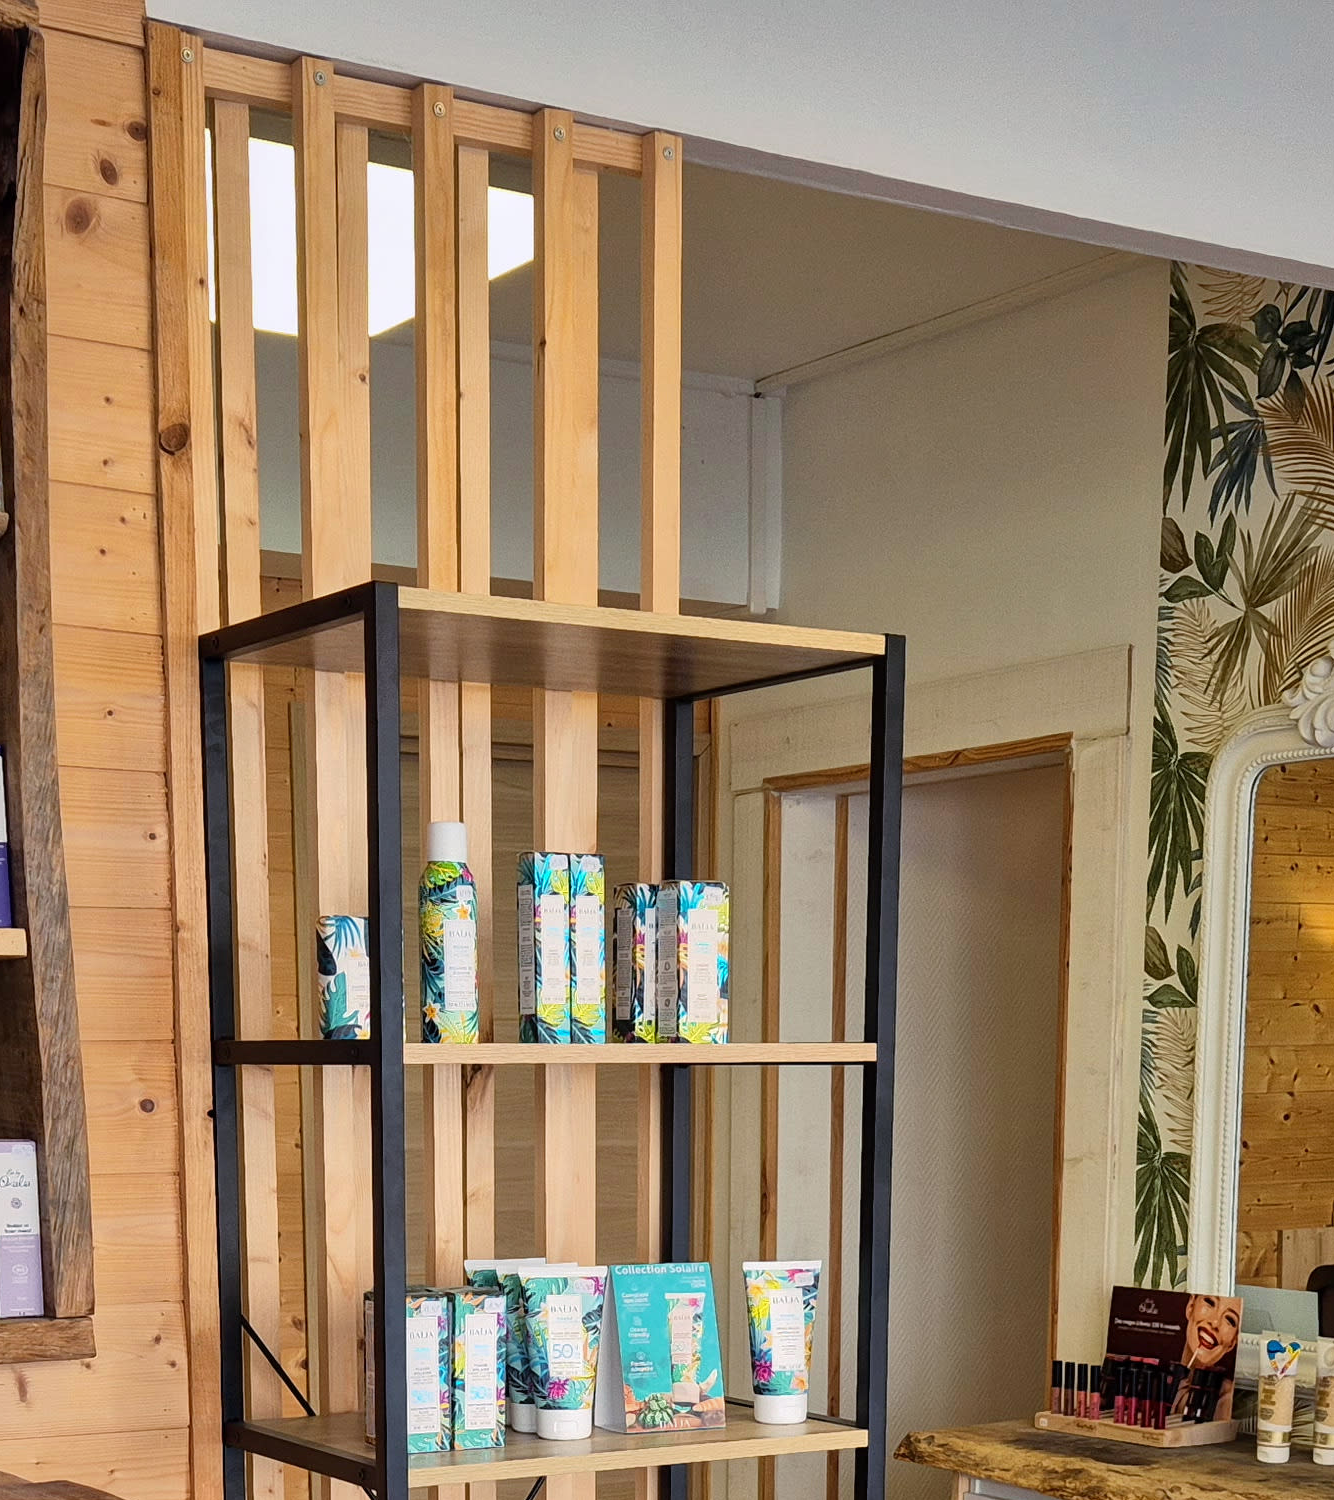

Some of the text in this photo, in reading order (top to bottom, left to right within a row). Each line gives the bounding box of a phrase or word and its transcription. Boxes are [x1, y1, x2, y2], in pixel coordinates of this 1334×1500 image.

[614, 1264, 705, 1275] Collection Solaire
[550, 1305, 579, 1313] BAÏJA
